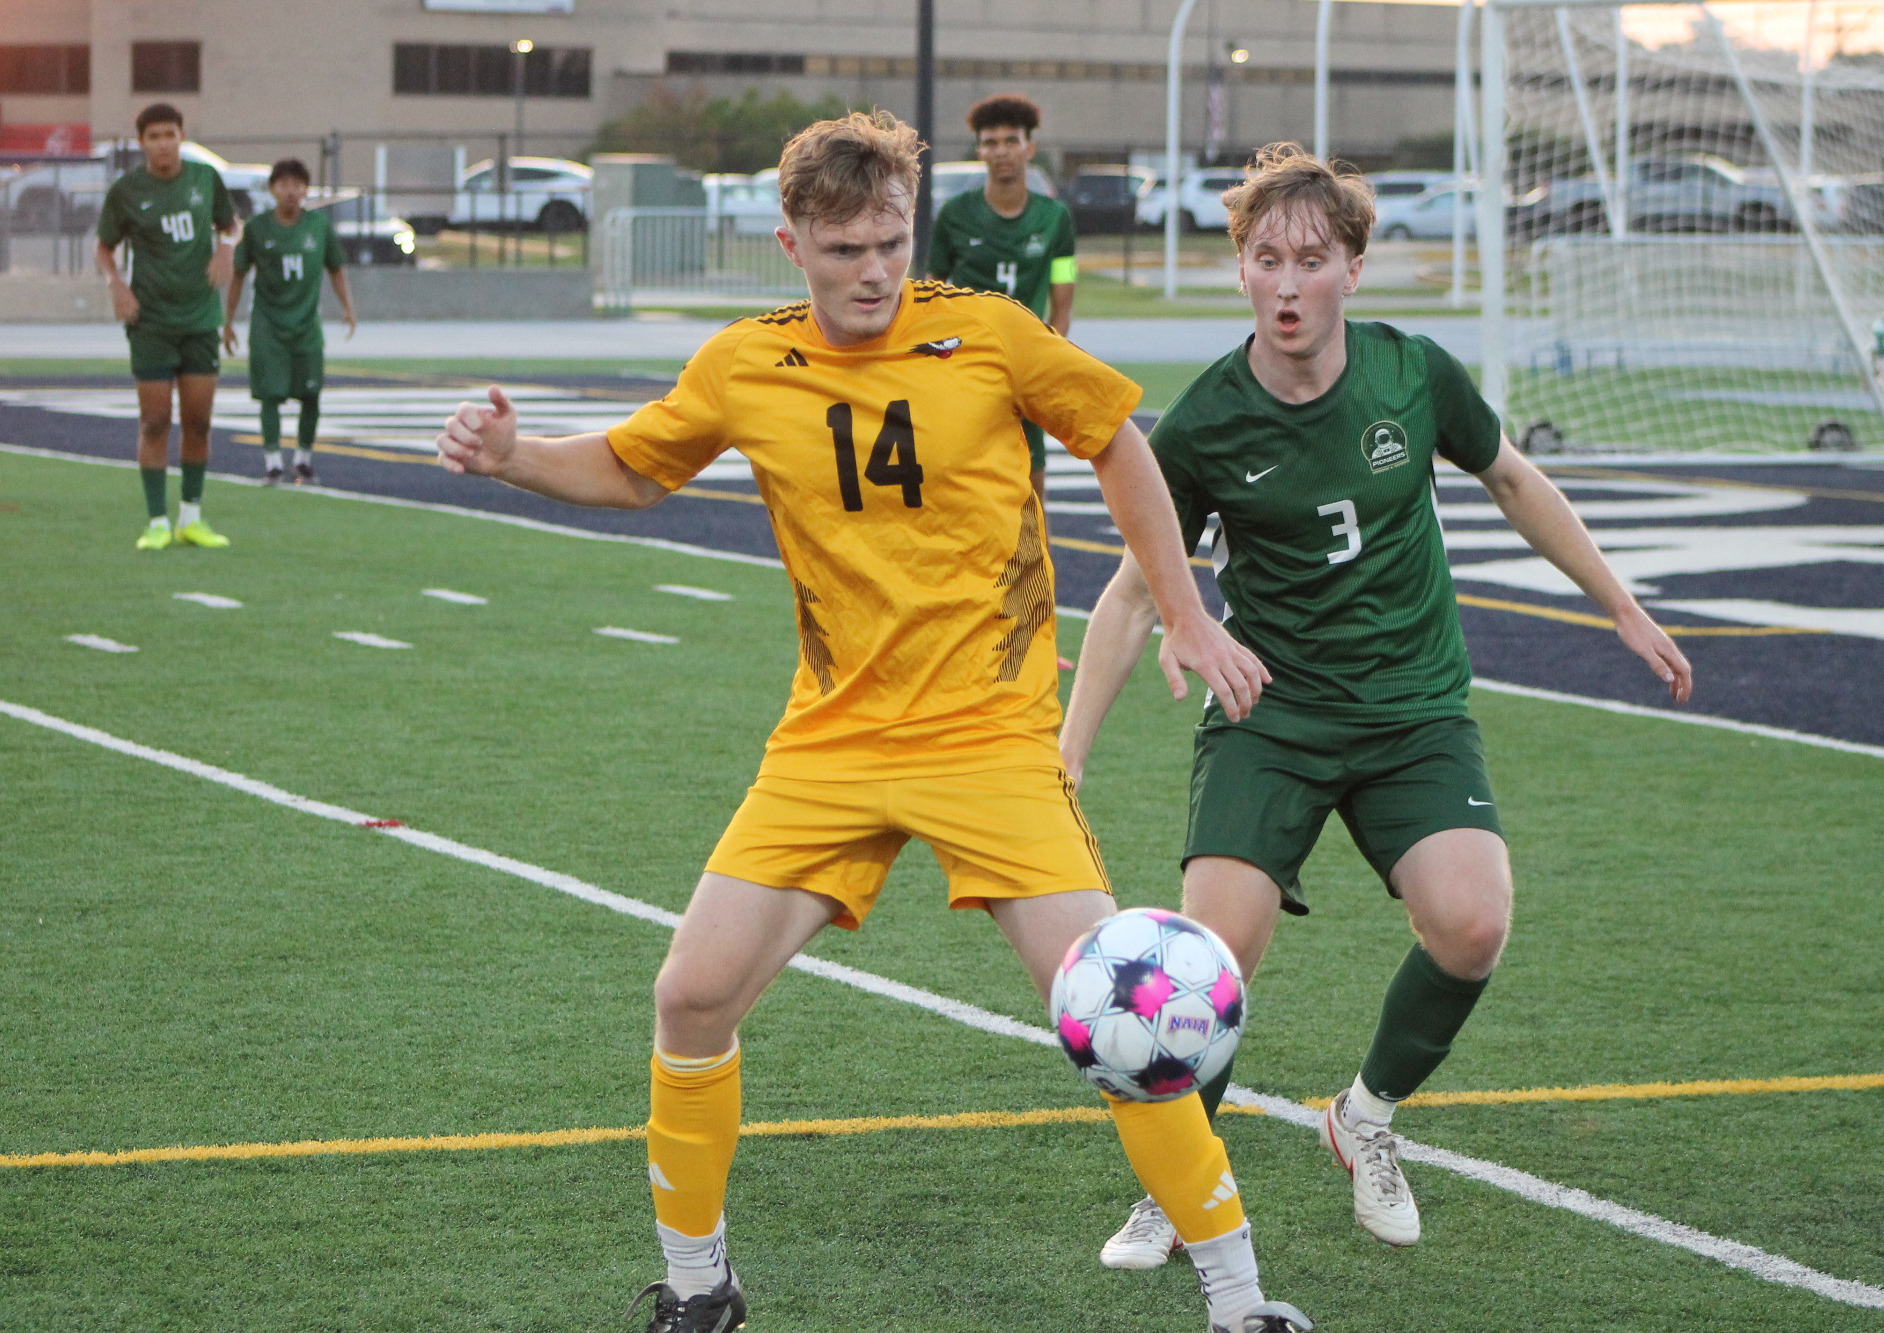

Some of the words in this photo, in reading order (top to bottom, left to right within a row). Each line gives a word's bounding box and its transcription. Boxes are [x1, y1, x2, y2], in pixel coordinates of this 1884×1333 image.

[161, 211, 194, 243] 40
[282, 254, 303, 281] 14
[996, 262, 1017, 296] 4
[826, 399, 924, 512] 14
[1372, 452, 1406, 468] PIONEERS
[1317, 500, 1362, 564] 3
[1168, 1015, 1208, 1037] NAIA
